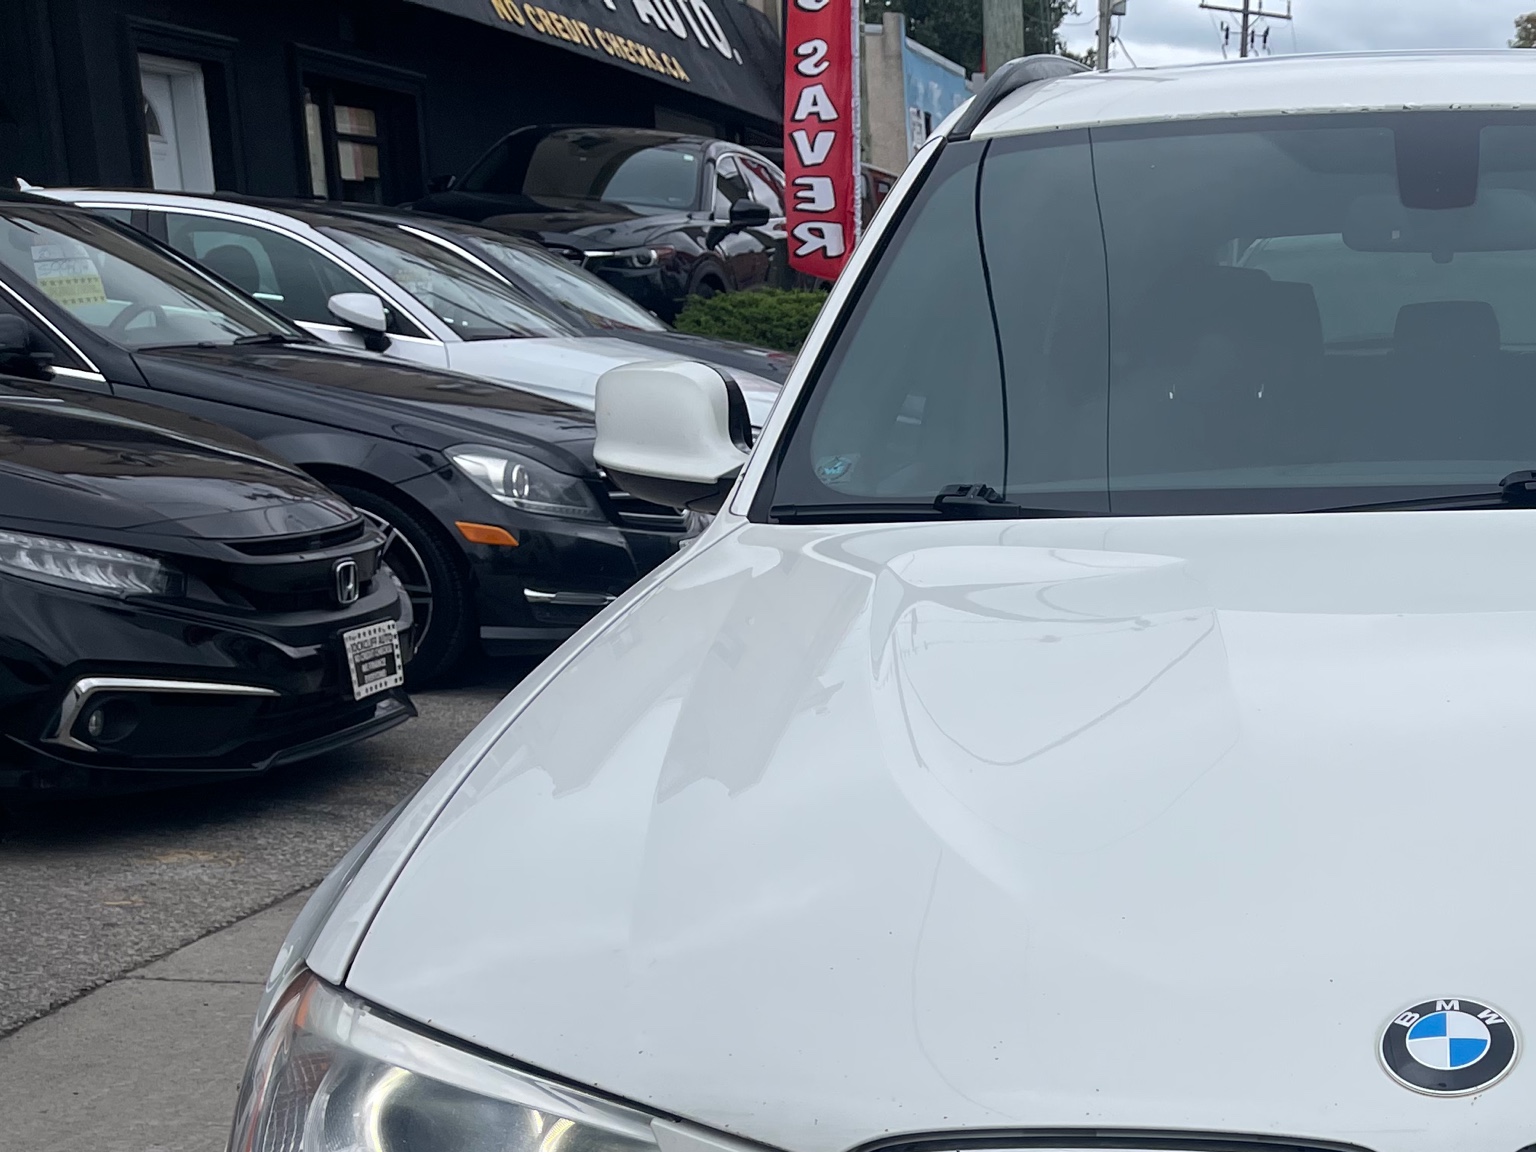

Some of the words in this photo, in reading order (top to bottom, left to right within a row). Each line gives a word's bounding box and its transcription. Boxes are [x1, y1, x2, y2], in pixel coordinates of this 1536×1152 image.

[491, 0, 525, 26] NO
[523, 3, 599, 49] CREDIT
[1394, 1000, 1504, 1027] BMW
